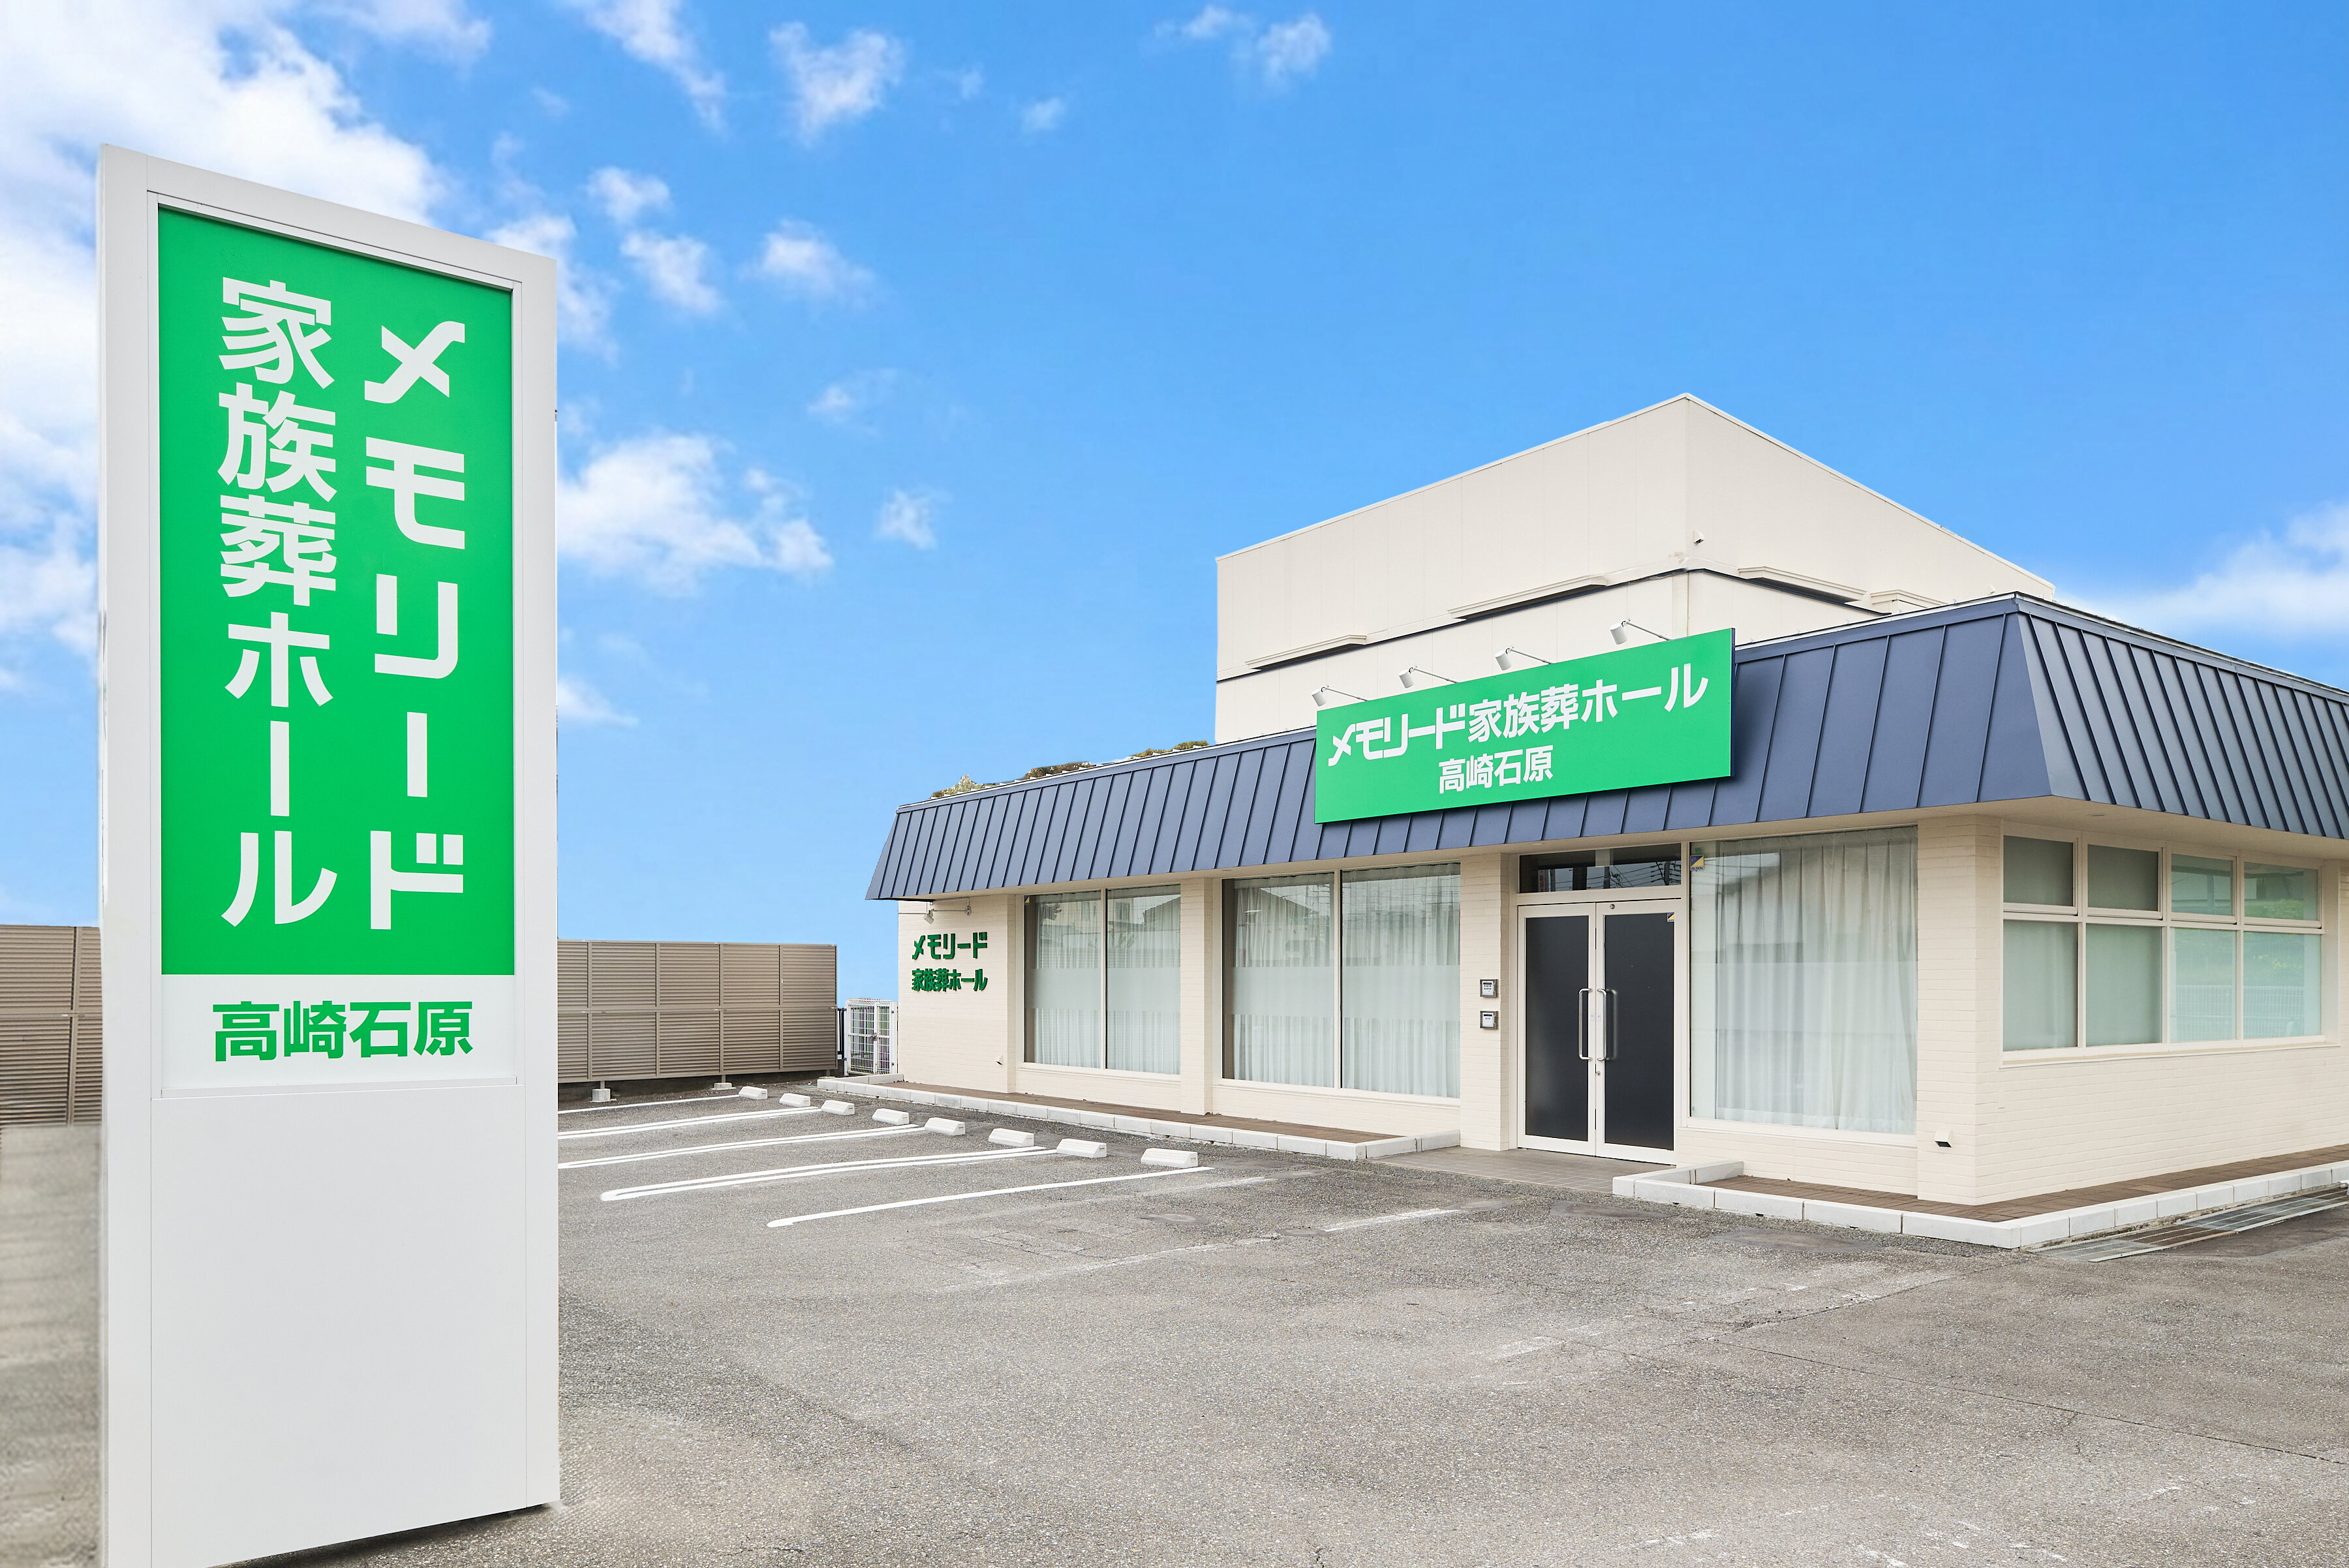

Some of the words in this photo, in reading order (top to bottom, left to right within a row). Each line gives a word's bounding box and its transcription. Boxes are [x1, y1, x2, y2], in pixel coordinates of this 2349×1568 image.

[217, 277, 337, 927] 家族葬ホール
[365, 320, 465, 930] メモリード
[1439, 745, 1553, 793] 高崎石原
[912, 932, 988, 960] メモリード
[912, 968, 988, 992] 家族葬ホール
[213, 1000, 473, 1062] 高崎石原
